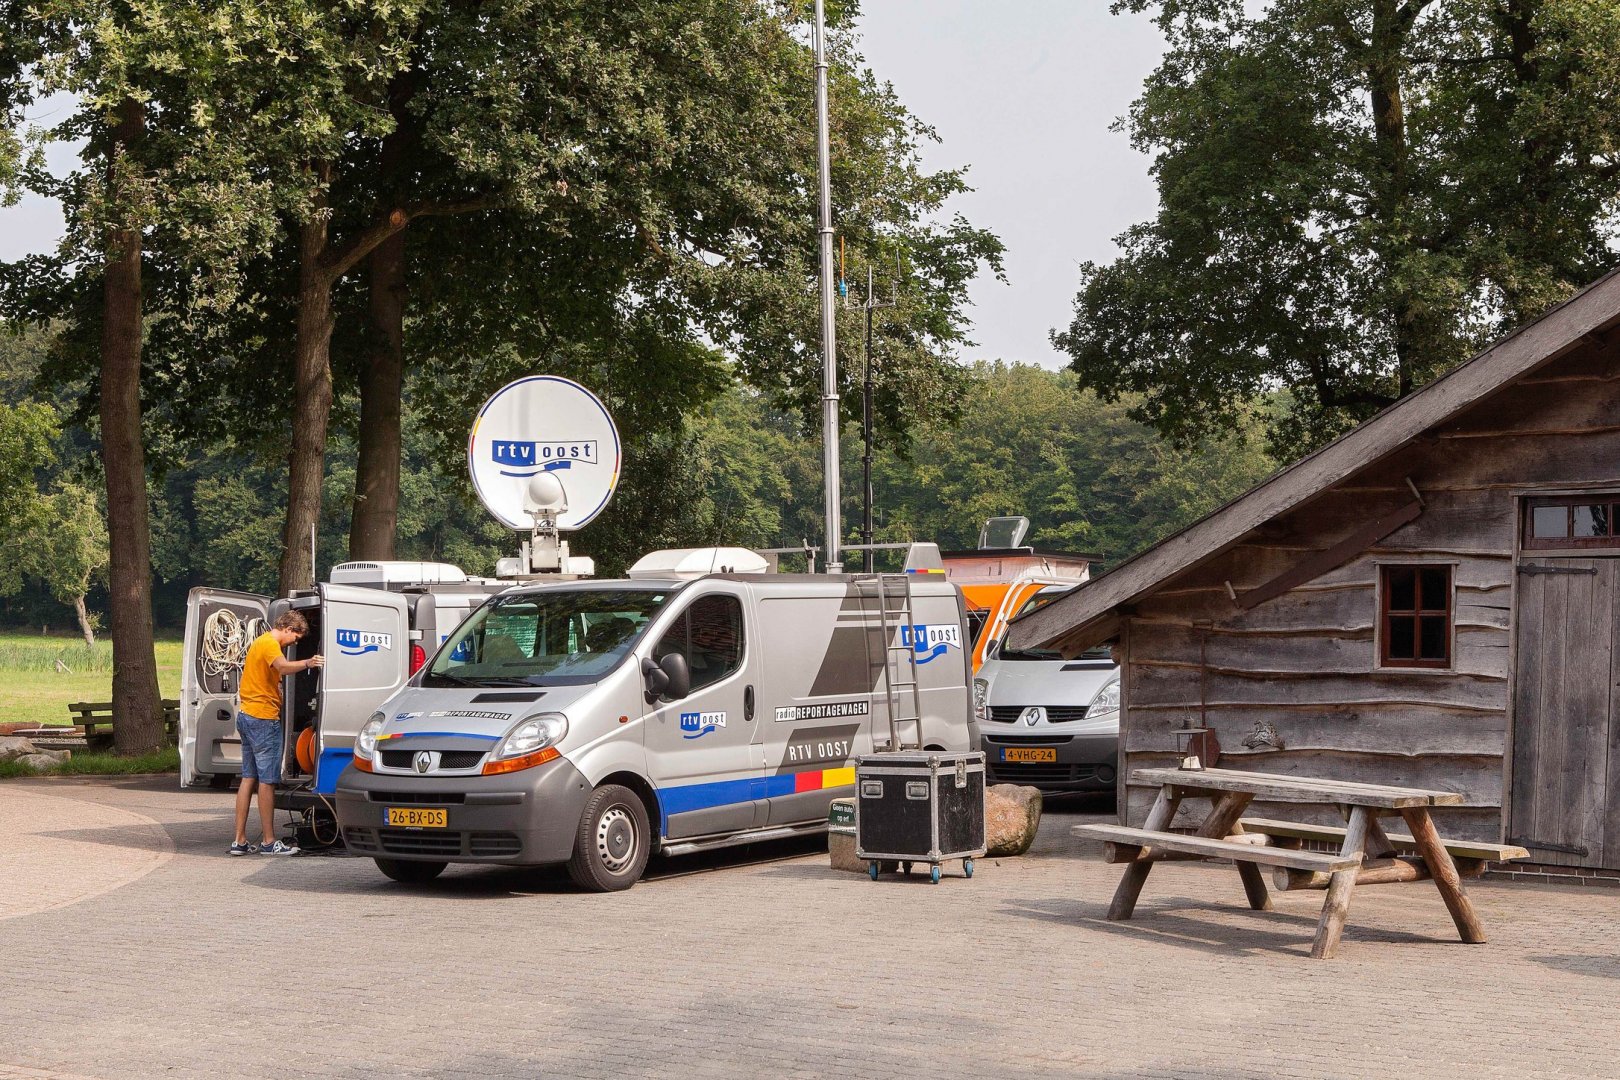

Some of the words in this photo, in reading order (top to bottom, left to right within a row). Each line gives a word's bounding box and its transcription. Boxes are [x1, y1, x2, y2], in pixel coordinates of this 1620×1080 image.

[497, 443, 530, 458] rtv
[542, 443, 591, 458] oost
[339, 631, 358, 642] rtv
[363, 635, 388, 645] oost
[930, 627, 957, 642] oost
[776, 706, 796, 720] radio
[796, 702, 868, 719] REPORTAGEWAGEN
[682, 714, 698, 726] rtv
[702, 713, 724, 724] oost
[788, 744, 812, 761] RTV
[818, 741, 849, 758] OOST
[1008, 750, 1053, 760] 4-VHG-24
[391, 810, 443, 825] 26-BX-DS
